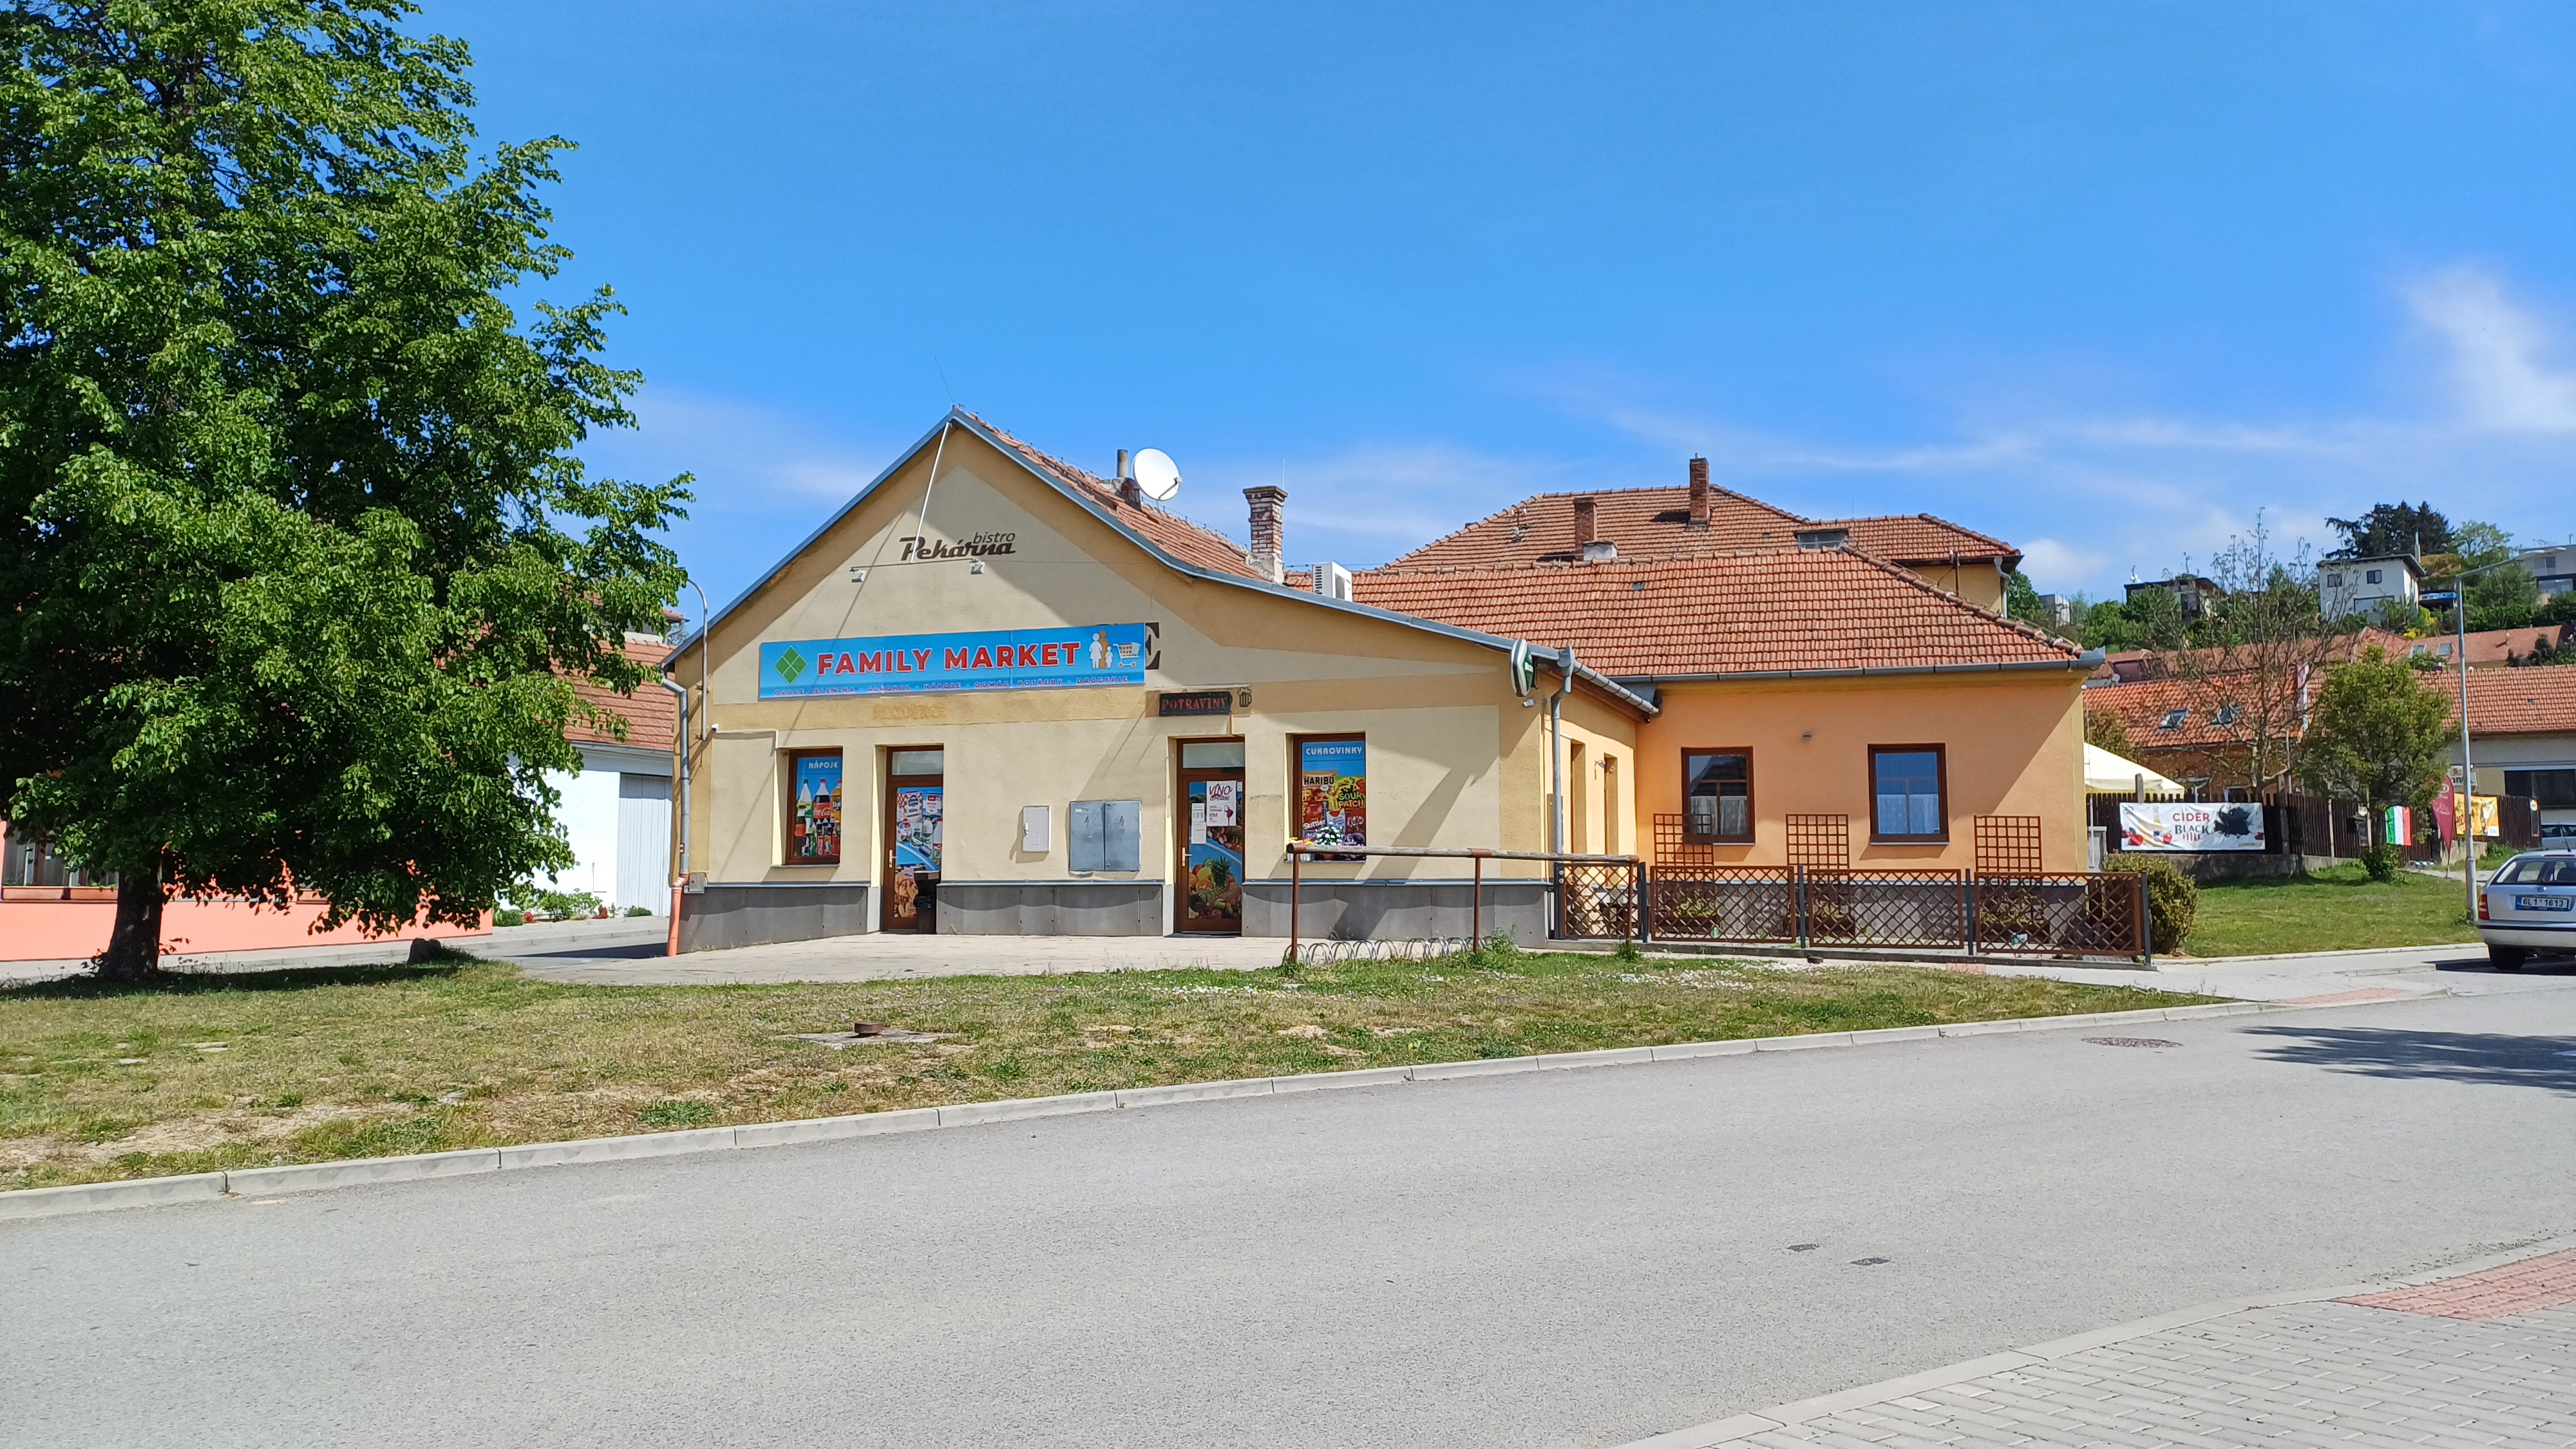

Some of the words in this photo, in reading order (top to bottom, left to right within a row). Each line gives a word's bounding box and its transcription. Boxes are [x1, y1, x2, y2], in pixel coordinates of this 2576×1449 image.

[973, 532, 1016, 544] bistro
[899, 536, 1016, 561] Pekárna
[818, 647, 933, 676] FAMILY
[943, 641, 1081, 670] MARKET
[1162, 697, 1227, 710] POTRAVINY
[1306, 746, 1362, 755] CUKROVINKY
[809, 760, 838, 769] NÁPOJE
[1304, 777, 1334, 785] HARIBO
[2173, 812, 2210, 822] CIDER
[2175, 825, 2210, 835] BLACK
